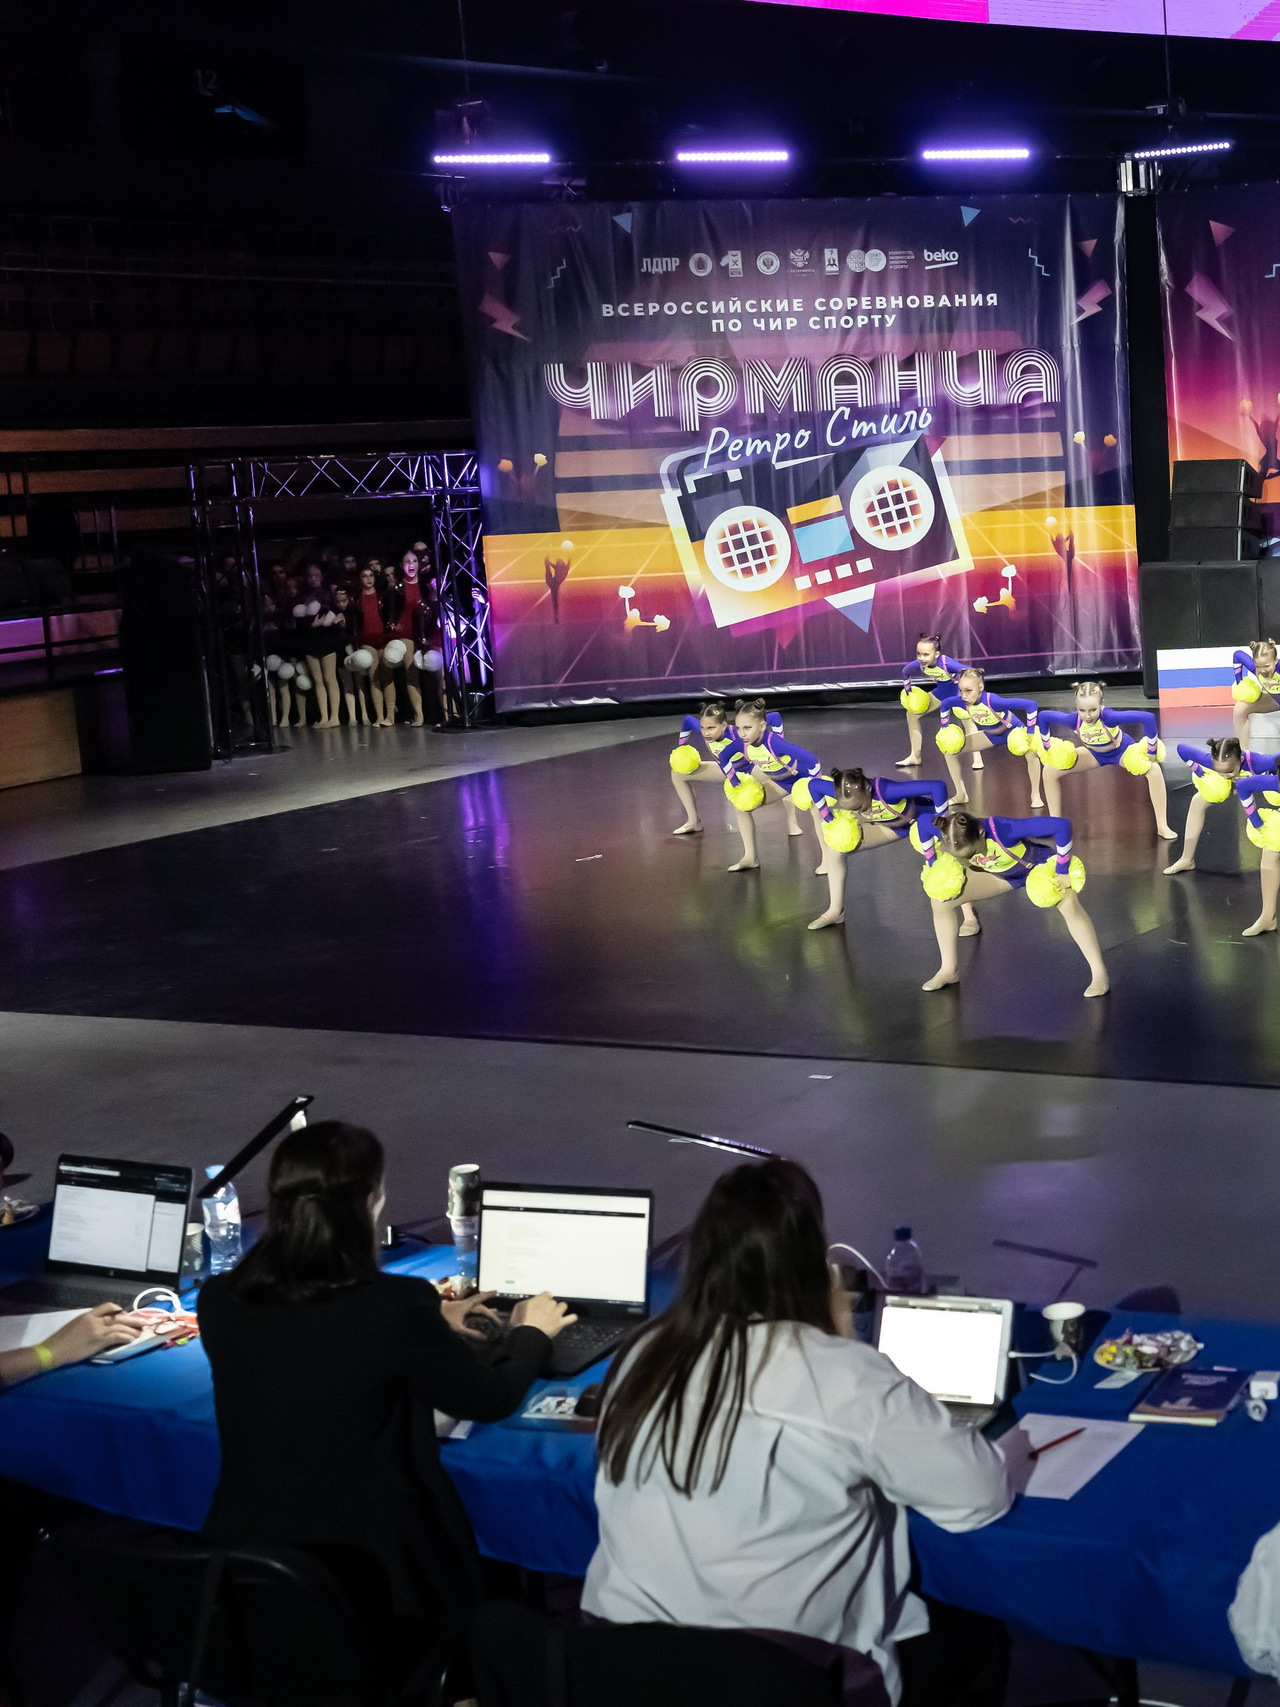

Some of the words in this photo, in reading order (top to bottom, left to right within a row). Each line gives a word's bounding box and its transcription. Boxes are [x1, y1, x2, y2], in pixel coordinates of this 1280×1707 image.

[923, 249, 959, 262] beko
[640, 257, 680, 274] ЛДПР
[602, 297, 804, 317] ВСЕРОССИЙСКИЕ
[814, 293, 998, 311] СОРЕВНОВАНИЯ
[711, 318, 742, 332] ПО
[752, 317, 798, 331] ЧИР
[808, 314, 897, 330] СПОРТУ
[703, 426, 812, 469] Ретро
[825, 405, 933, 448] Стиль
